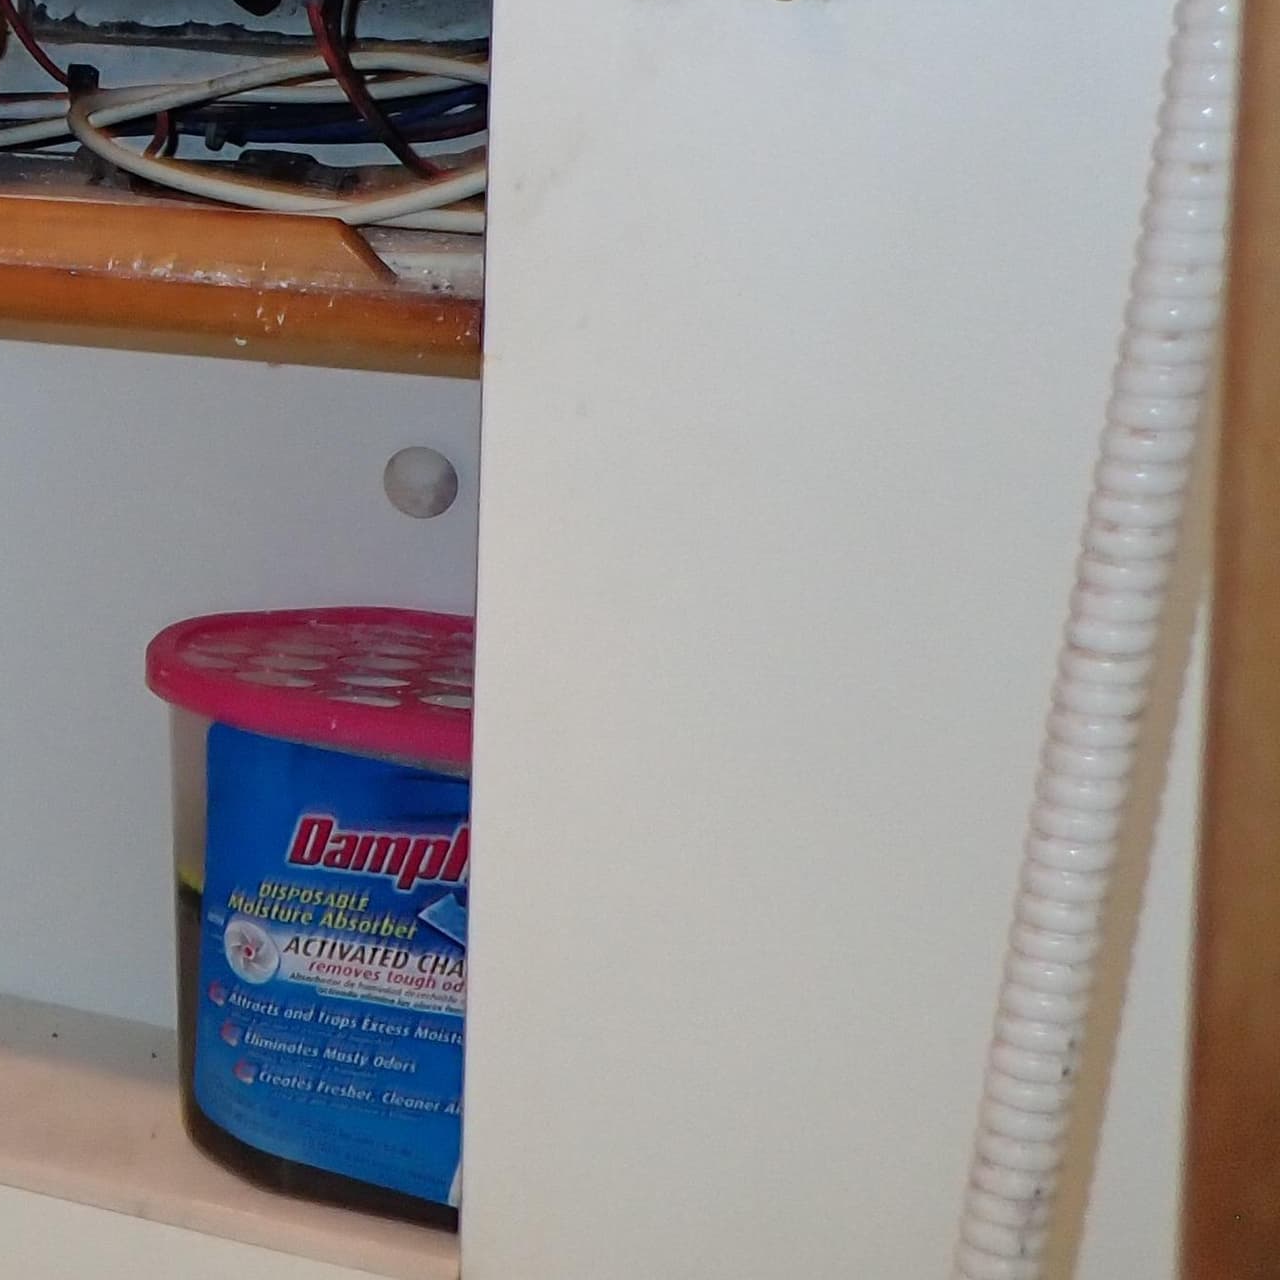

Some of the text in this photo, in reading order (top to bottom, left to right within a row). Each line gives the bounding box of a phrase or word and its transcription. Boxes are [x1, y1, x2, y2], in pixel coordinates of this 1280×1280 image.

[228, 893, 419, 940] Moisture Absorber
[259, 881, 370, 912] DISPOSABLE
[283, 936, 409, 970] ACTIVATED
[308, 960, 380, 982] removes
[387, 970, 437, 991] tough
[228, 991, 279, 1017] Attracts
[283, 1002, 314, 1021] and
[317, 1010, 357, 1031] Traps
[361, 1017, 409, 1038] Excess
[244, 1031, 417, 1073] Eliminates Musty Odors
[258, 1069, 313, 1092] Creates
[382, 1091, 440, 1114] Cleaner
